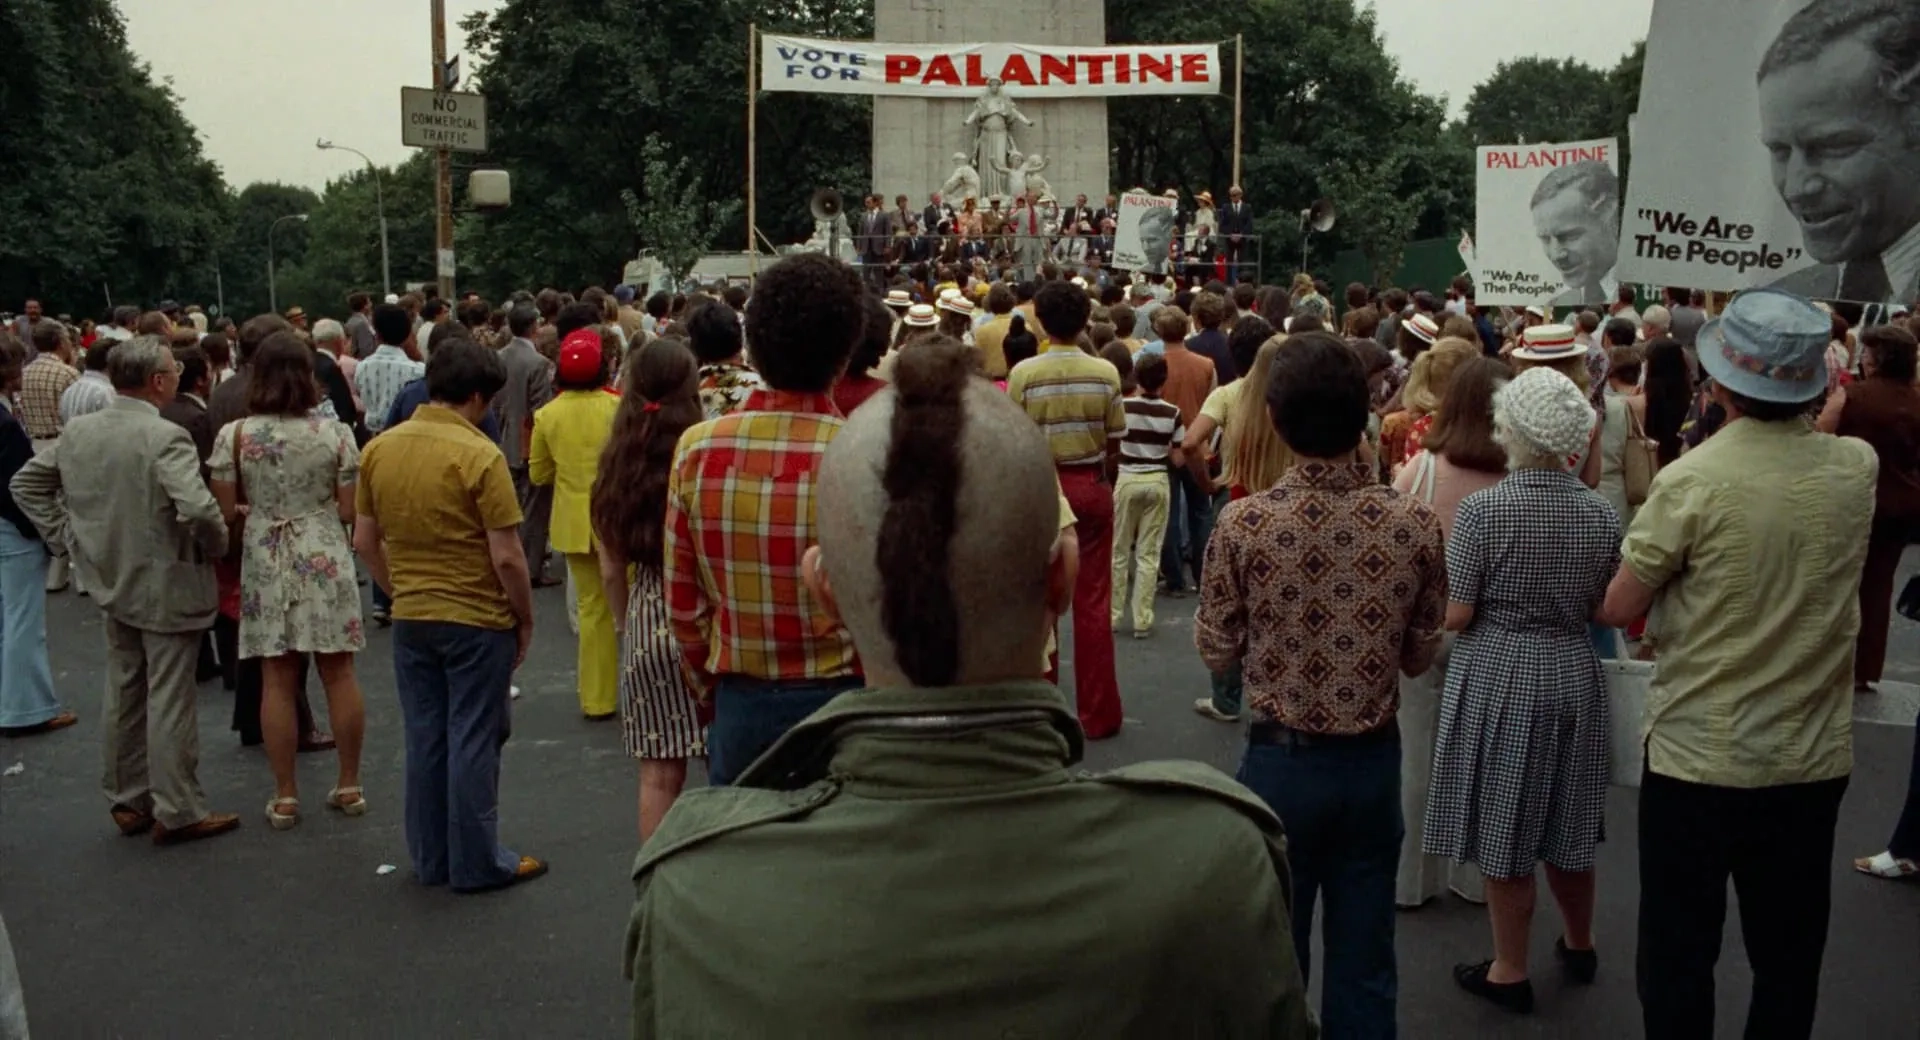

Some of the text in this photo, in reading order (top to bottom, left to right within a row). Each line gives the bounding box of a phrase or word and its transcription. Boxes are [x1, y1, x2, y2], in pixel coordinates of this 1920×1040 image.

[777, 46, 867, 66] VOTE
[786, 64, 860, 81] FOR
[885, 53, 1209, 86] PALANTINE
[432, 98, 458, 113] NO
[411, 112, 478, 130] COMMERCIAL
[423, 128, 468, 144] TRAFFIC
[1486, 144, 1609, 169] PALANTINE
[1638, 208, 1755, 241] "We Are
[1634, 234, 1802, 274] The People"
[1482, 269, 1539, 282] "We Are
[1482, 282, 1564, 297] The People"
